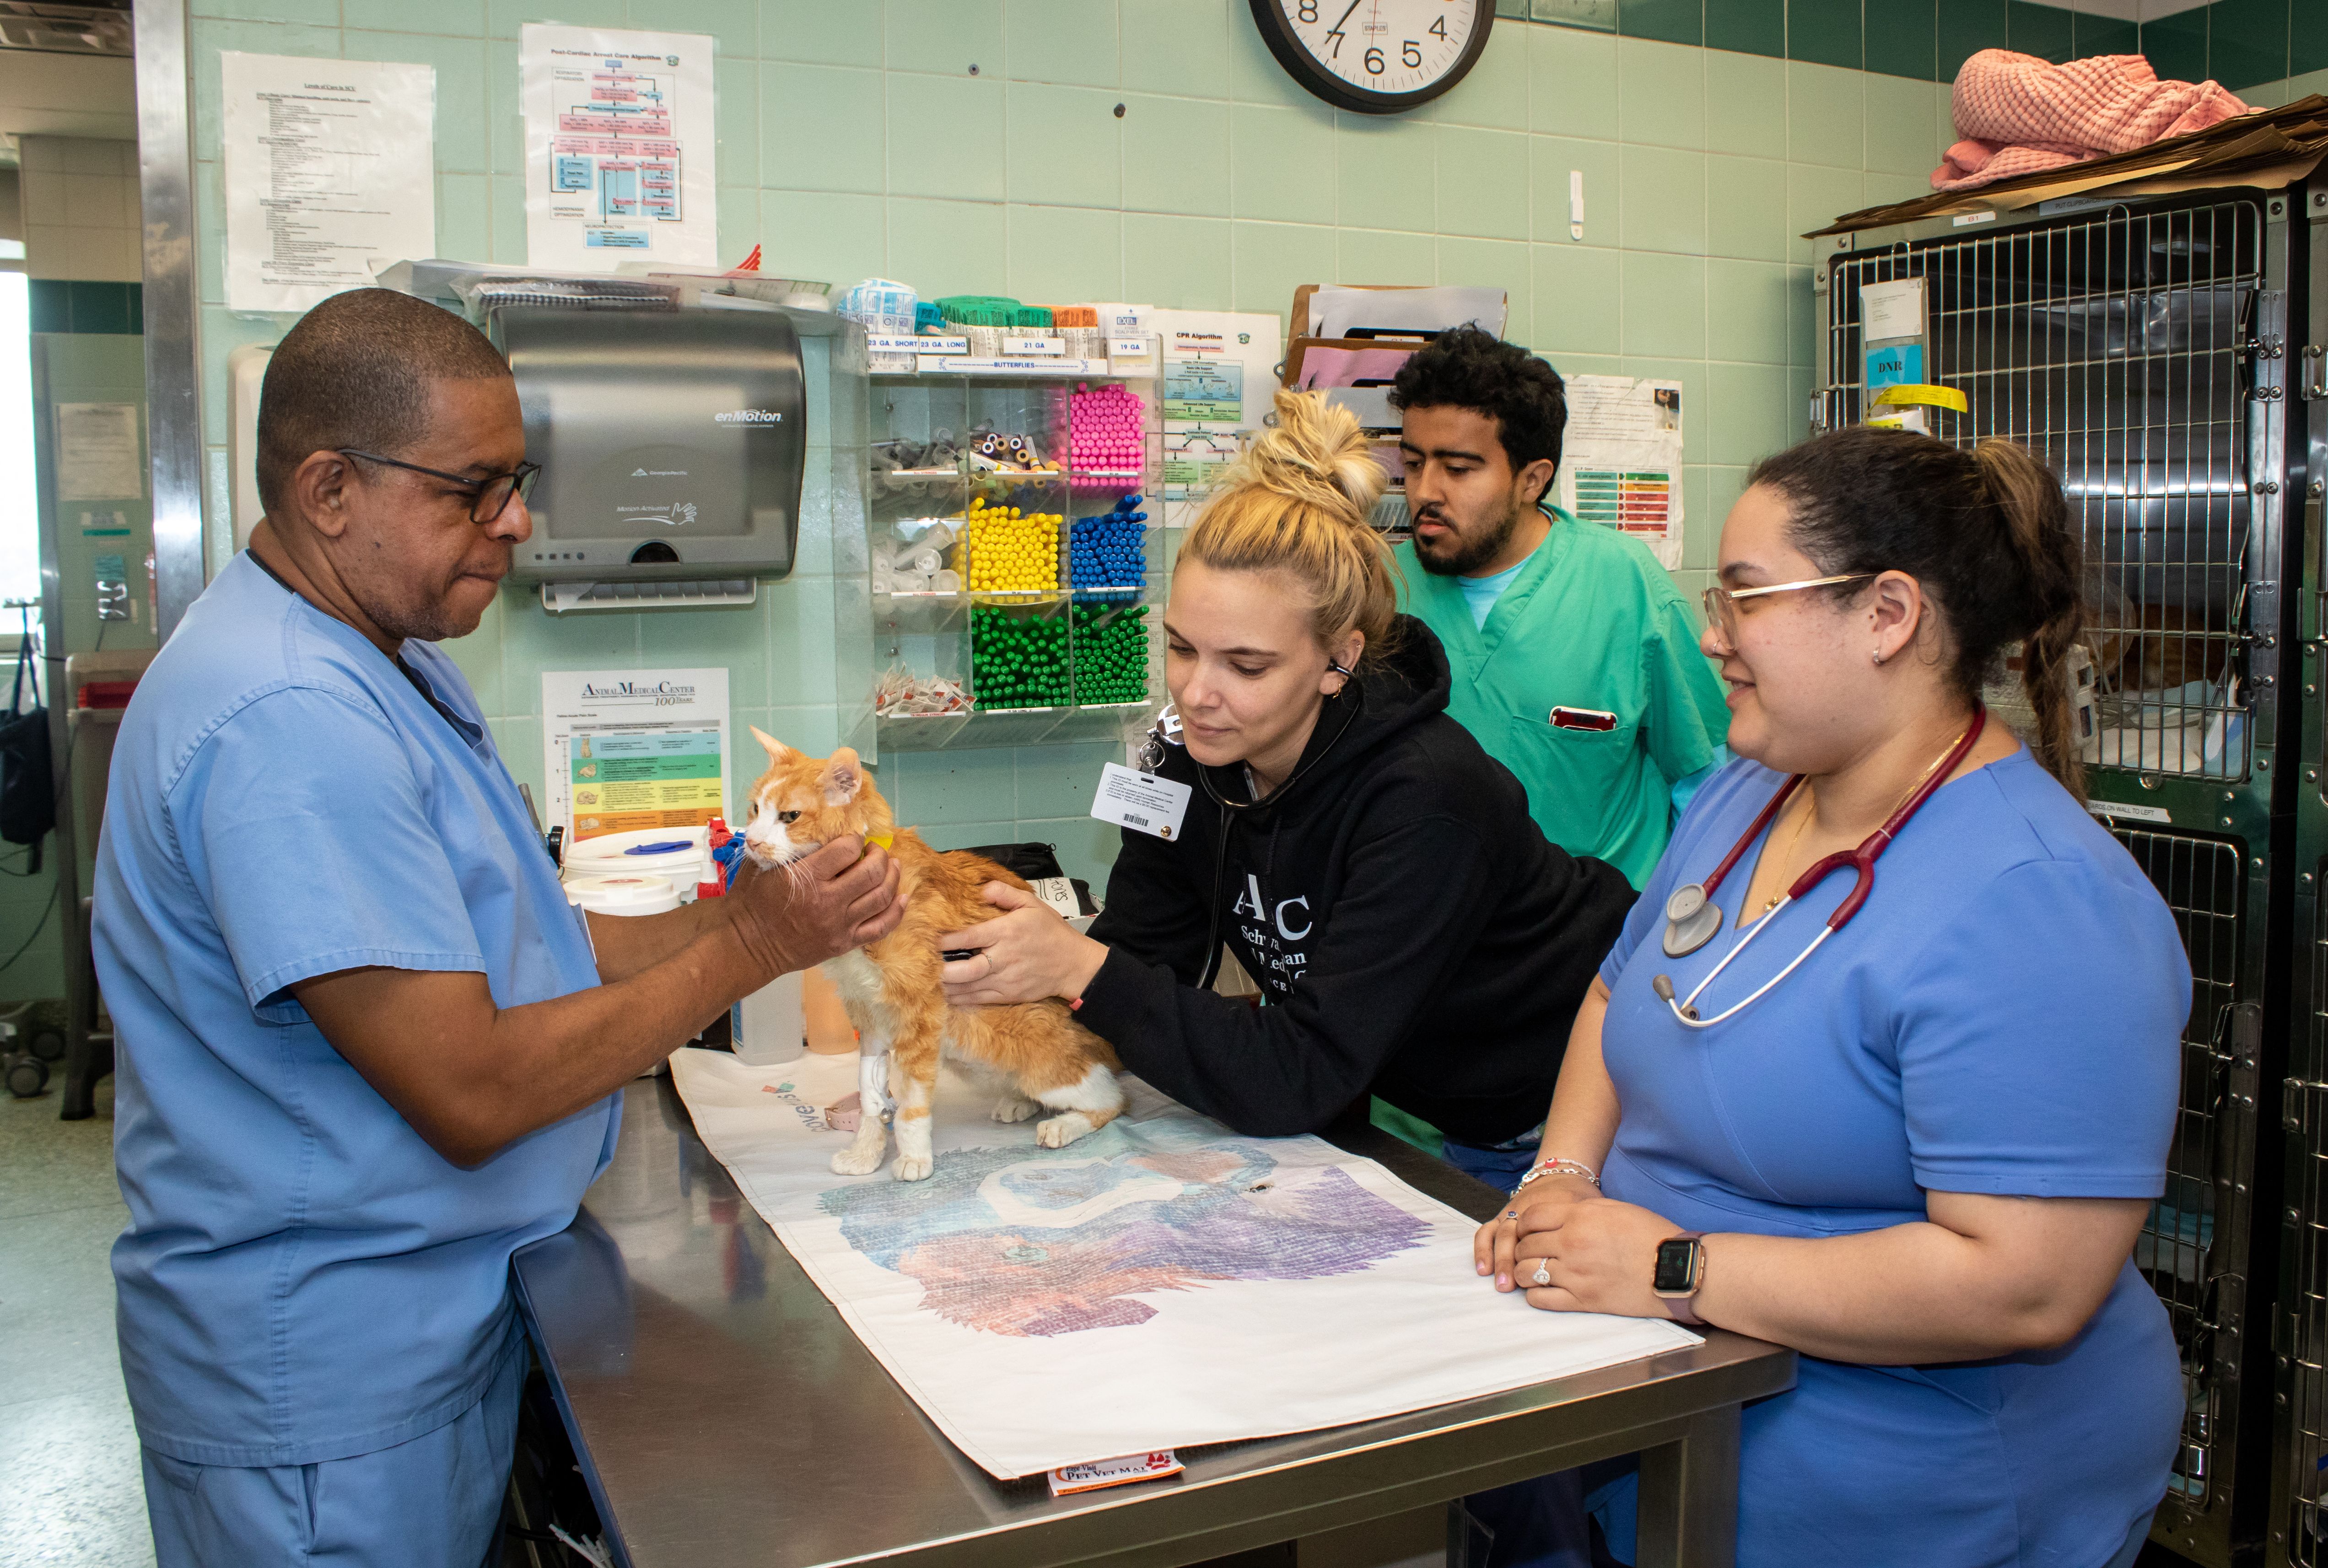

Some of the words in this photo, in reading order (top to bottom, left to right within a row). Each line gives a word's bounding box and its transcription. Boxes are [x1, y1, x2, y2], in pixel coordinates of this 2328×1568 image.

[1299, 0, 1318, 24] 8
[1429, 16, 1447, 41] 4
[1327, 30, 1345, 59] 7
[1402, 40, 1422, 68] 5
[1364, 48, 1385, 75] 6
[1117, 317, 1136, 325] EXEL
[1878, 361, 1902, 373] DNR
[715, 410, 782, 422] enMotion
[655, 697, 675, 706] 100
[1276, 895, 1312, 940] C
[1067, 1471, 1090, 1481] PET
